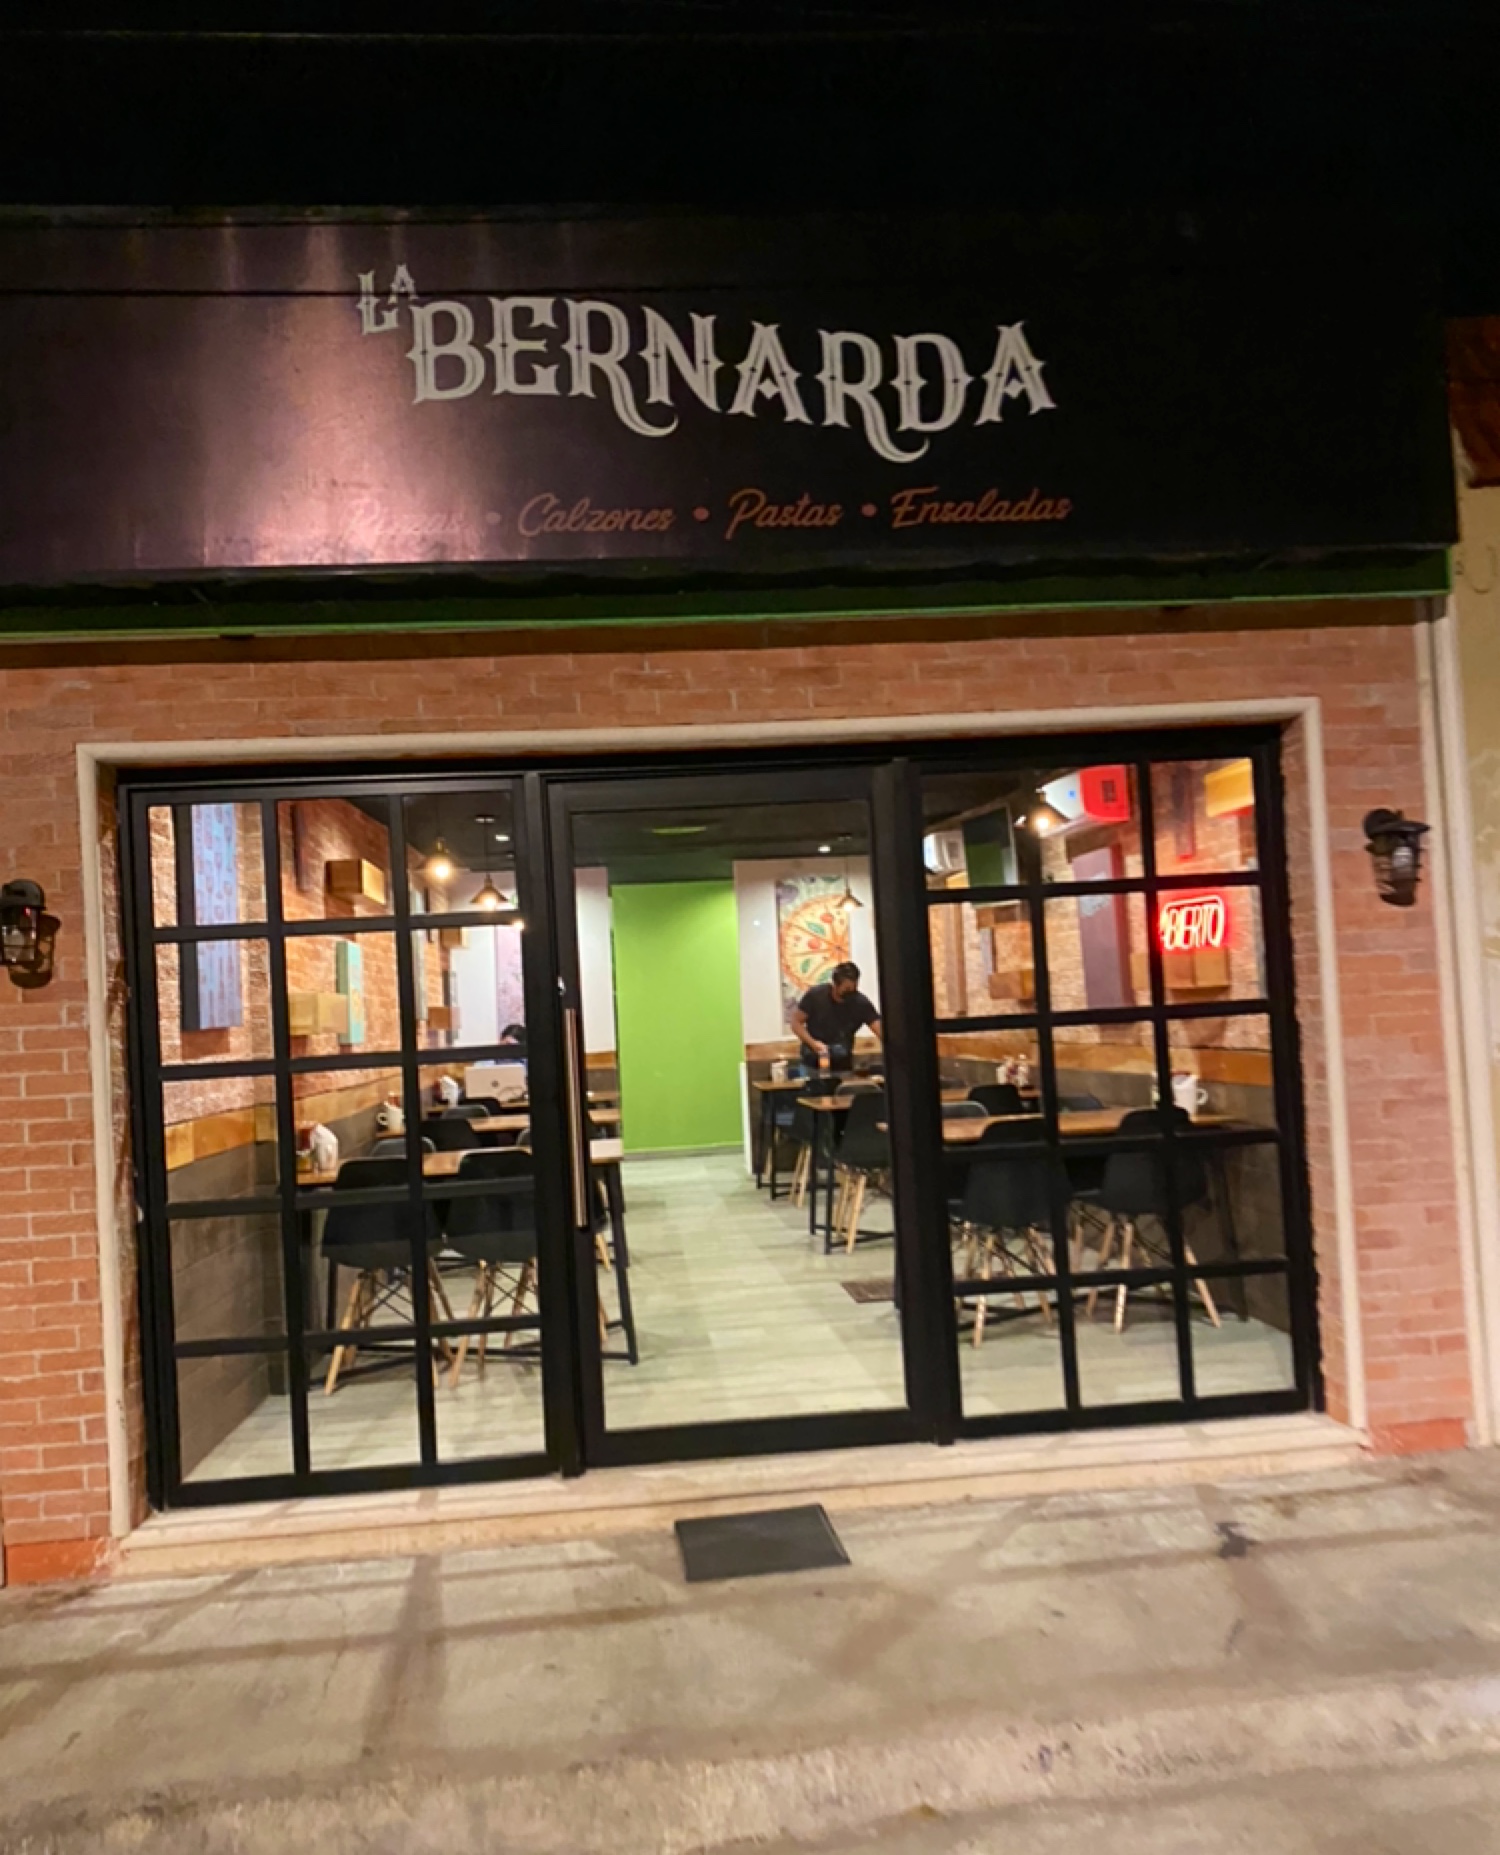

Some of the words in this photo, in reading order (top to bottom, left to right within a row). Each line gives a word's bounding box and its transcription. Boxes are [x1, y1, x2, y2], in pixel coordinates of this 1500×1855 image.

[357, 264, 418, 335] LA
[405, 296, 1057, 463] BERNARDA
[517, 492, 674, 537] Calzones
[725, 488, 842, 540] Pastas
[891, 486, 1072, 528] Ensaladas
